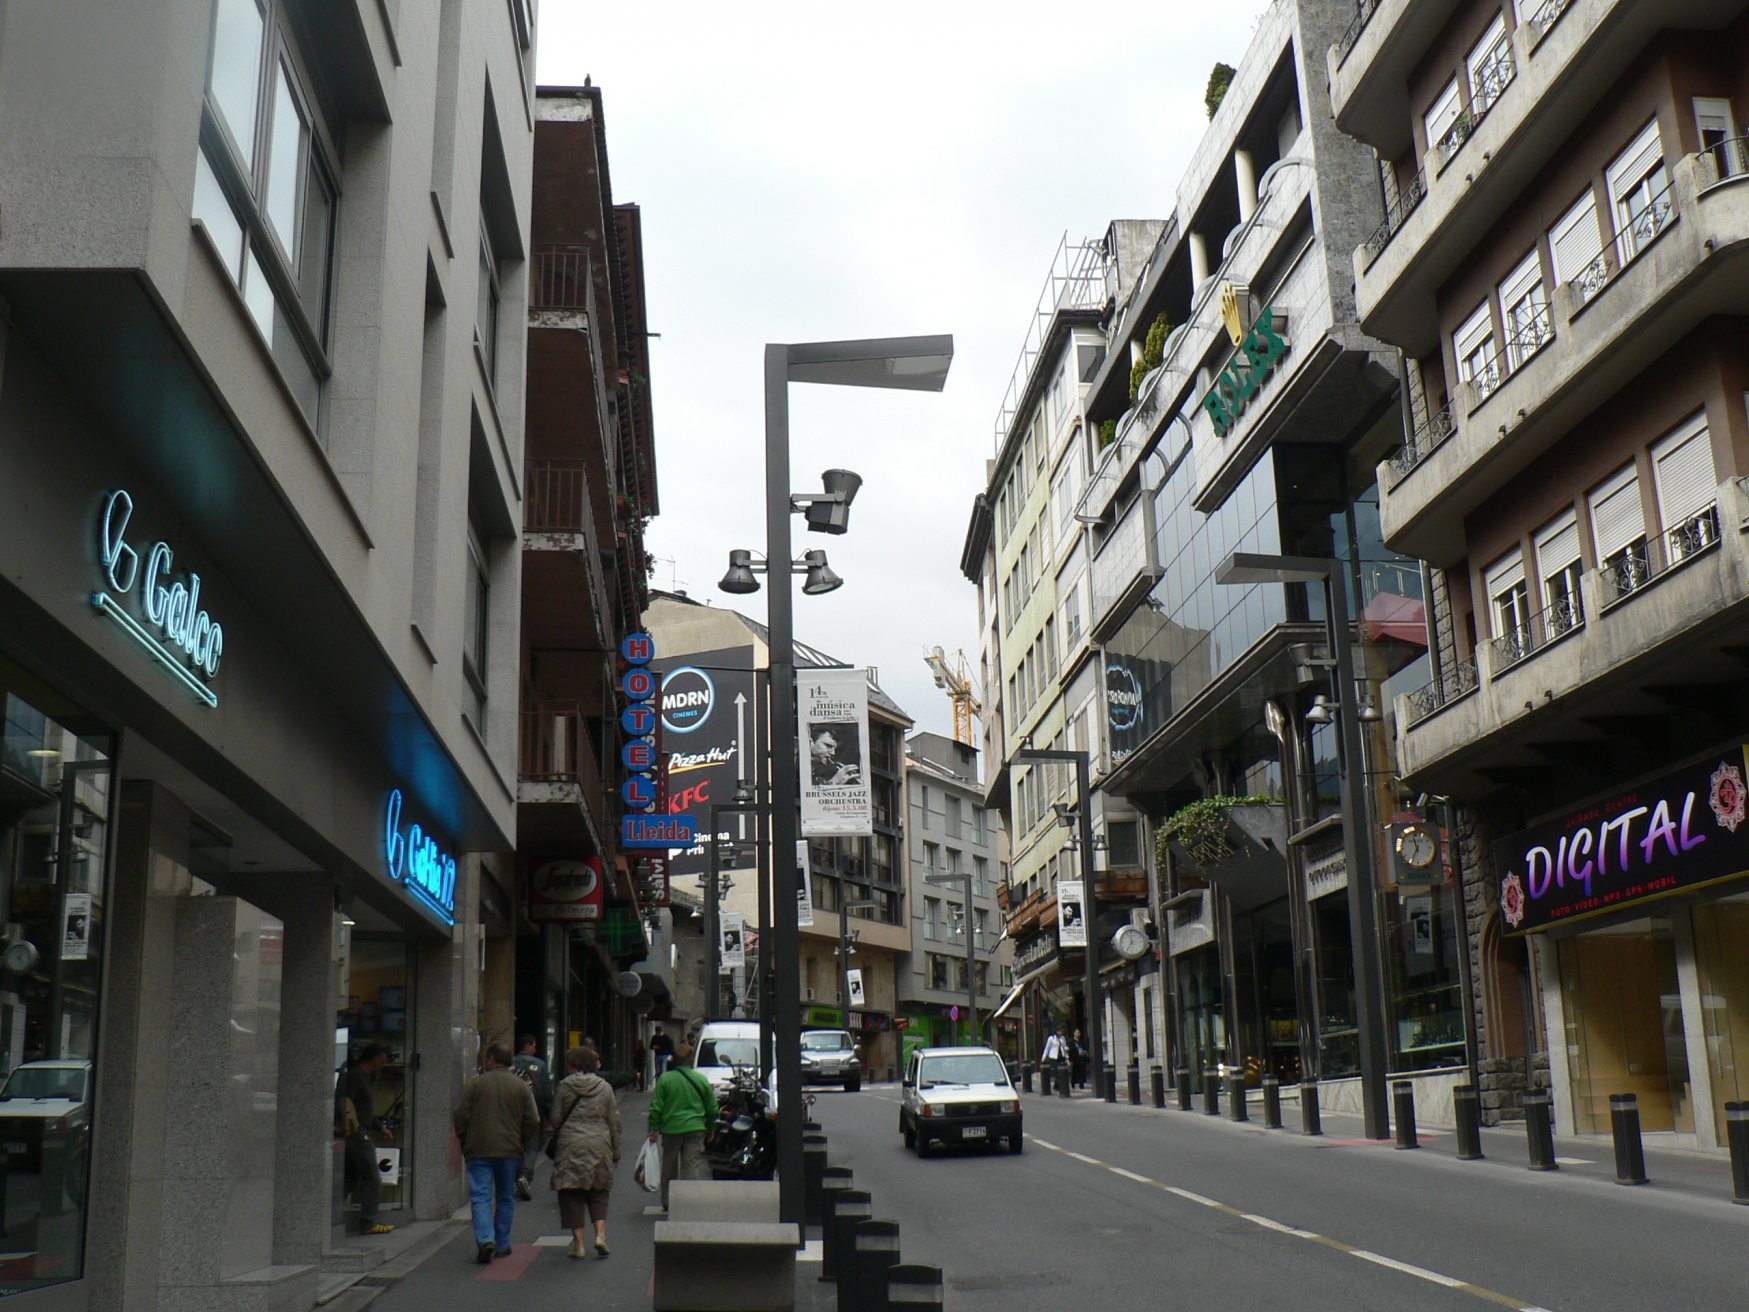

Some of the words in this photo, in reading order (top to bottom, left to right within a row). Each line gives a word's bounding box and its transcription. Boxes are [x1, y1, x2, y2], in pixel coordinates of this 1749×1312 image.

[1203, 306, 1285, 438] ROLEX
[662, 689, 709, 710] MDRN
[816, 700, 856, 709] música
[628, 638, 649, 802] HOTEL
[672, 709, 698, 719] CINEMES
[809, 705, 842, 717] dansa
[668, 751, 706, 770] Pizza
[706, 747, 738, 763] Hut
[668, 779, 711, 814] KFC
[818, 798, 867, 806] ORCHESTRA
[848, 790, 867, 798] JAZZ
[626, 820, 691, 842] Lleida
[1525, 791, 1706, 900] DIGITAL
